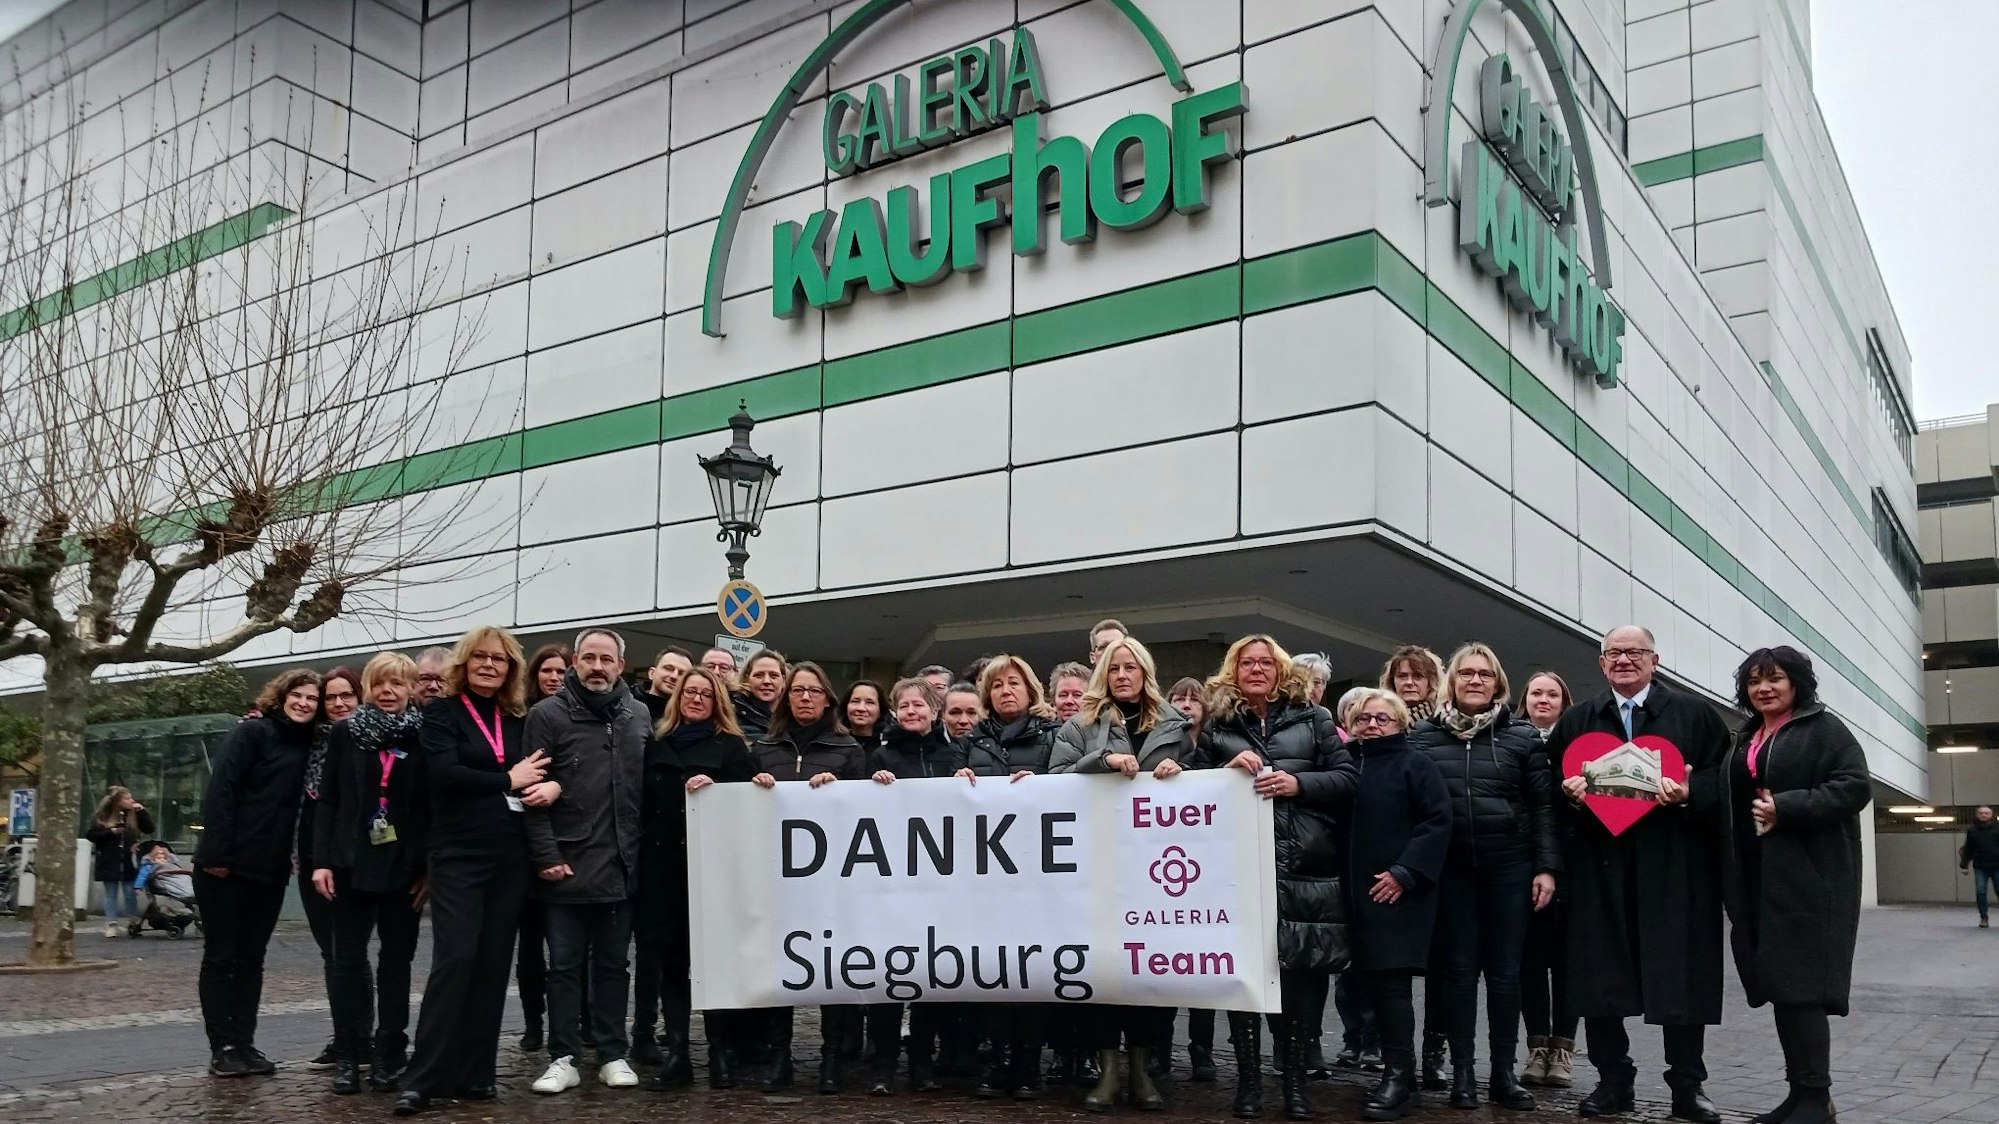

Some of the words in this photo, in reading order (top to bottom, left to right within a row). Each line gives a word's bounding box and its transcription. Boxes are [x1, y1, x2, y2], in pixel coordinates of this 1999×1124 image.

[823, 27, 1050, 176] GALERIA
[1480, 52, 1577, 224] GALERIA
[781, 812, 1078, 878] DANKE
[1132, 796, 1217, 828] Euer
[1125, 909, 1230, 925] GALERIA
[782, 926, 1093, 1001] Siegburg
[1123, 942, 1235, 975] Team
